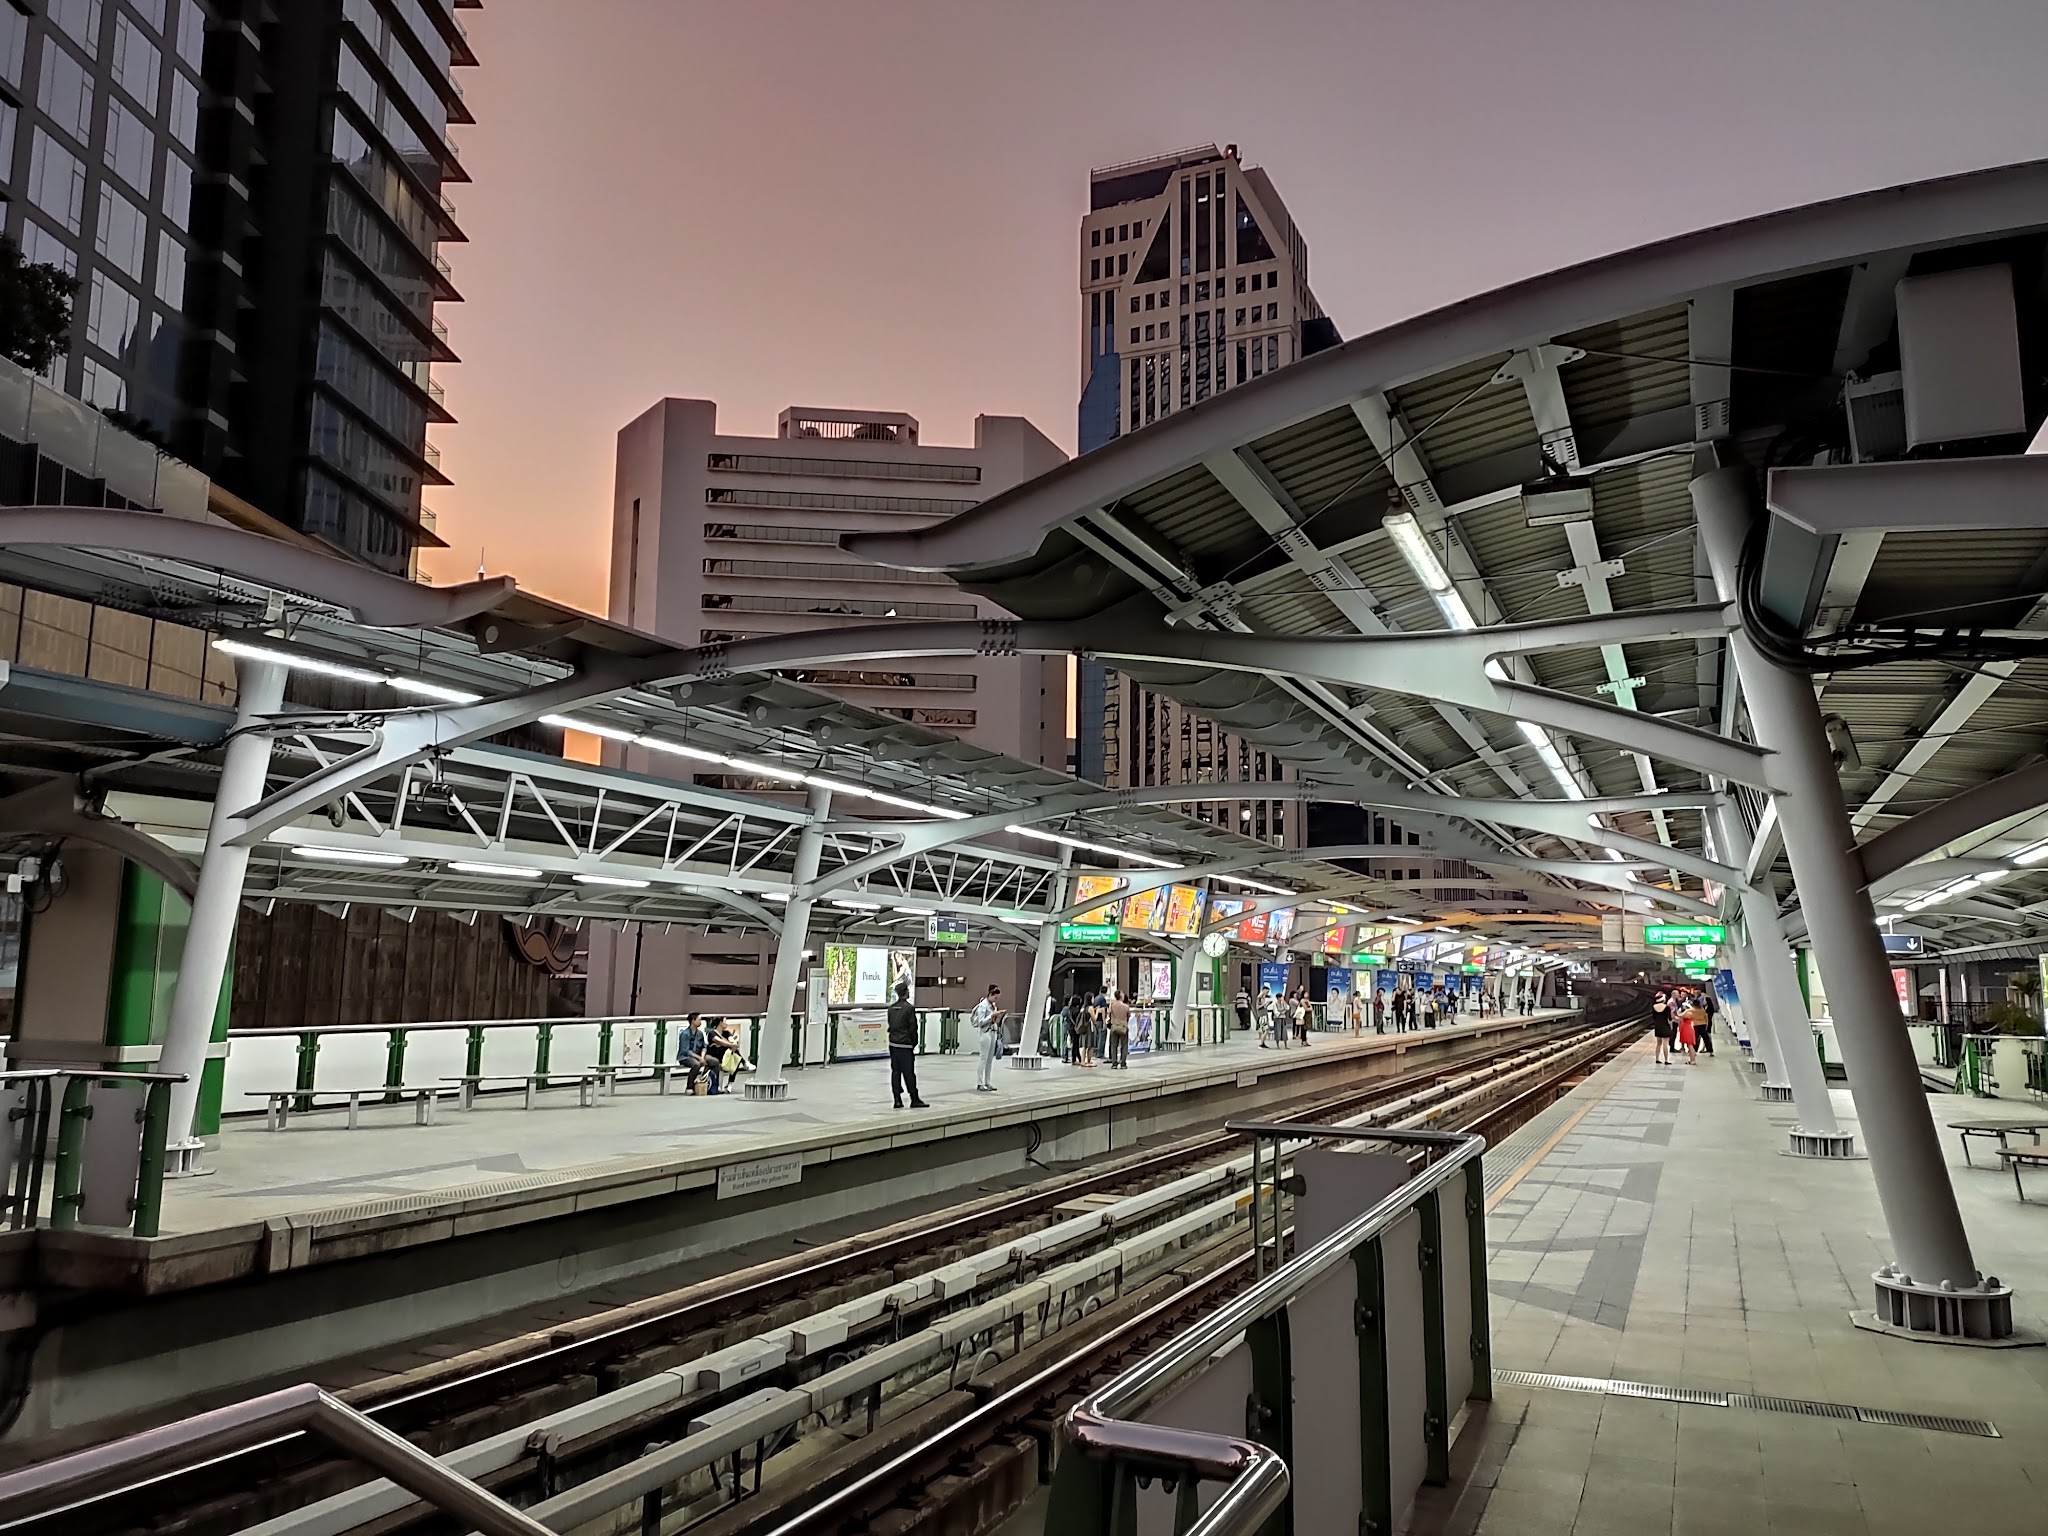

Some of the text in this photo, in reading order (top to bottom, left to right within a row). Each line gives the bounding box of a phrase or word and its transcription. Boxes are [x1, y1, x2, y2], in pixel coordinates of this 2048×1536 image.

[732, 1182, 745, 1190] Stand
[745, 1179, 760, 1188] behind
[768, 1174, 782, 1184] yellow
